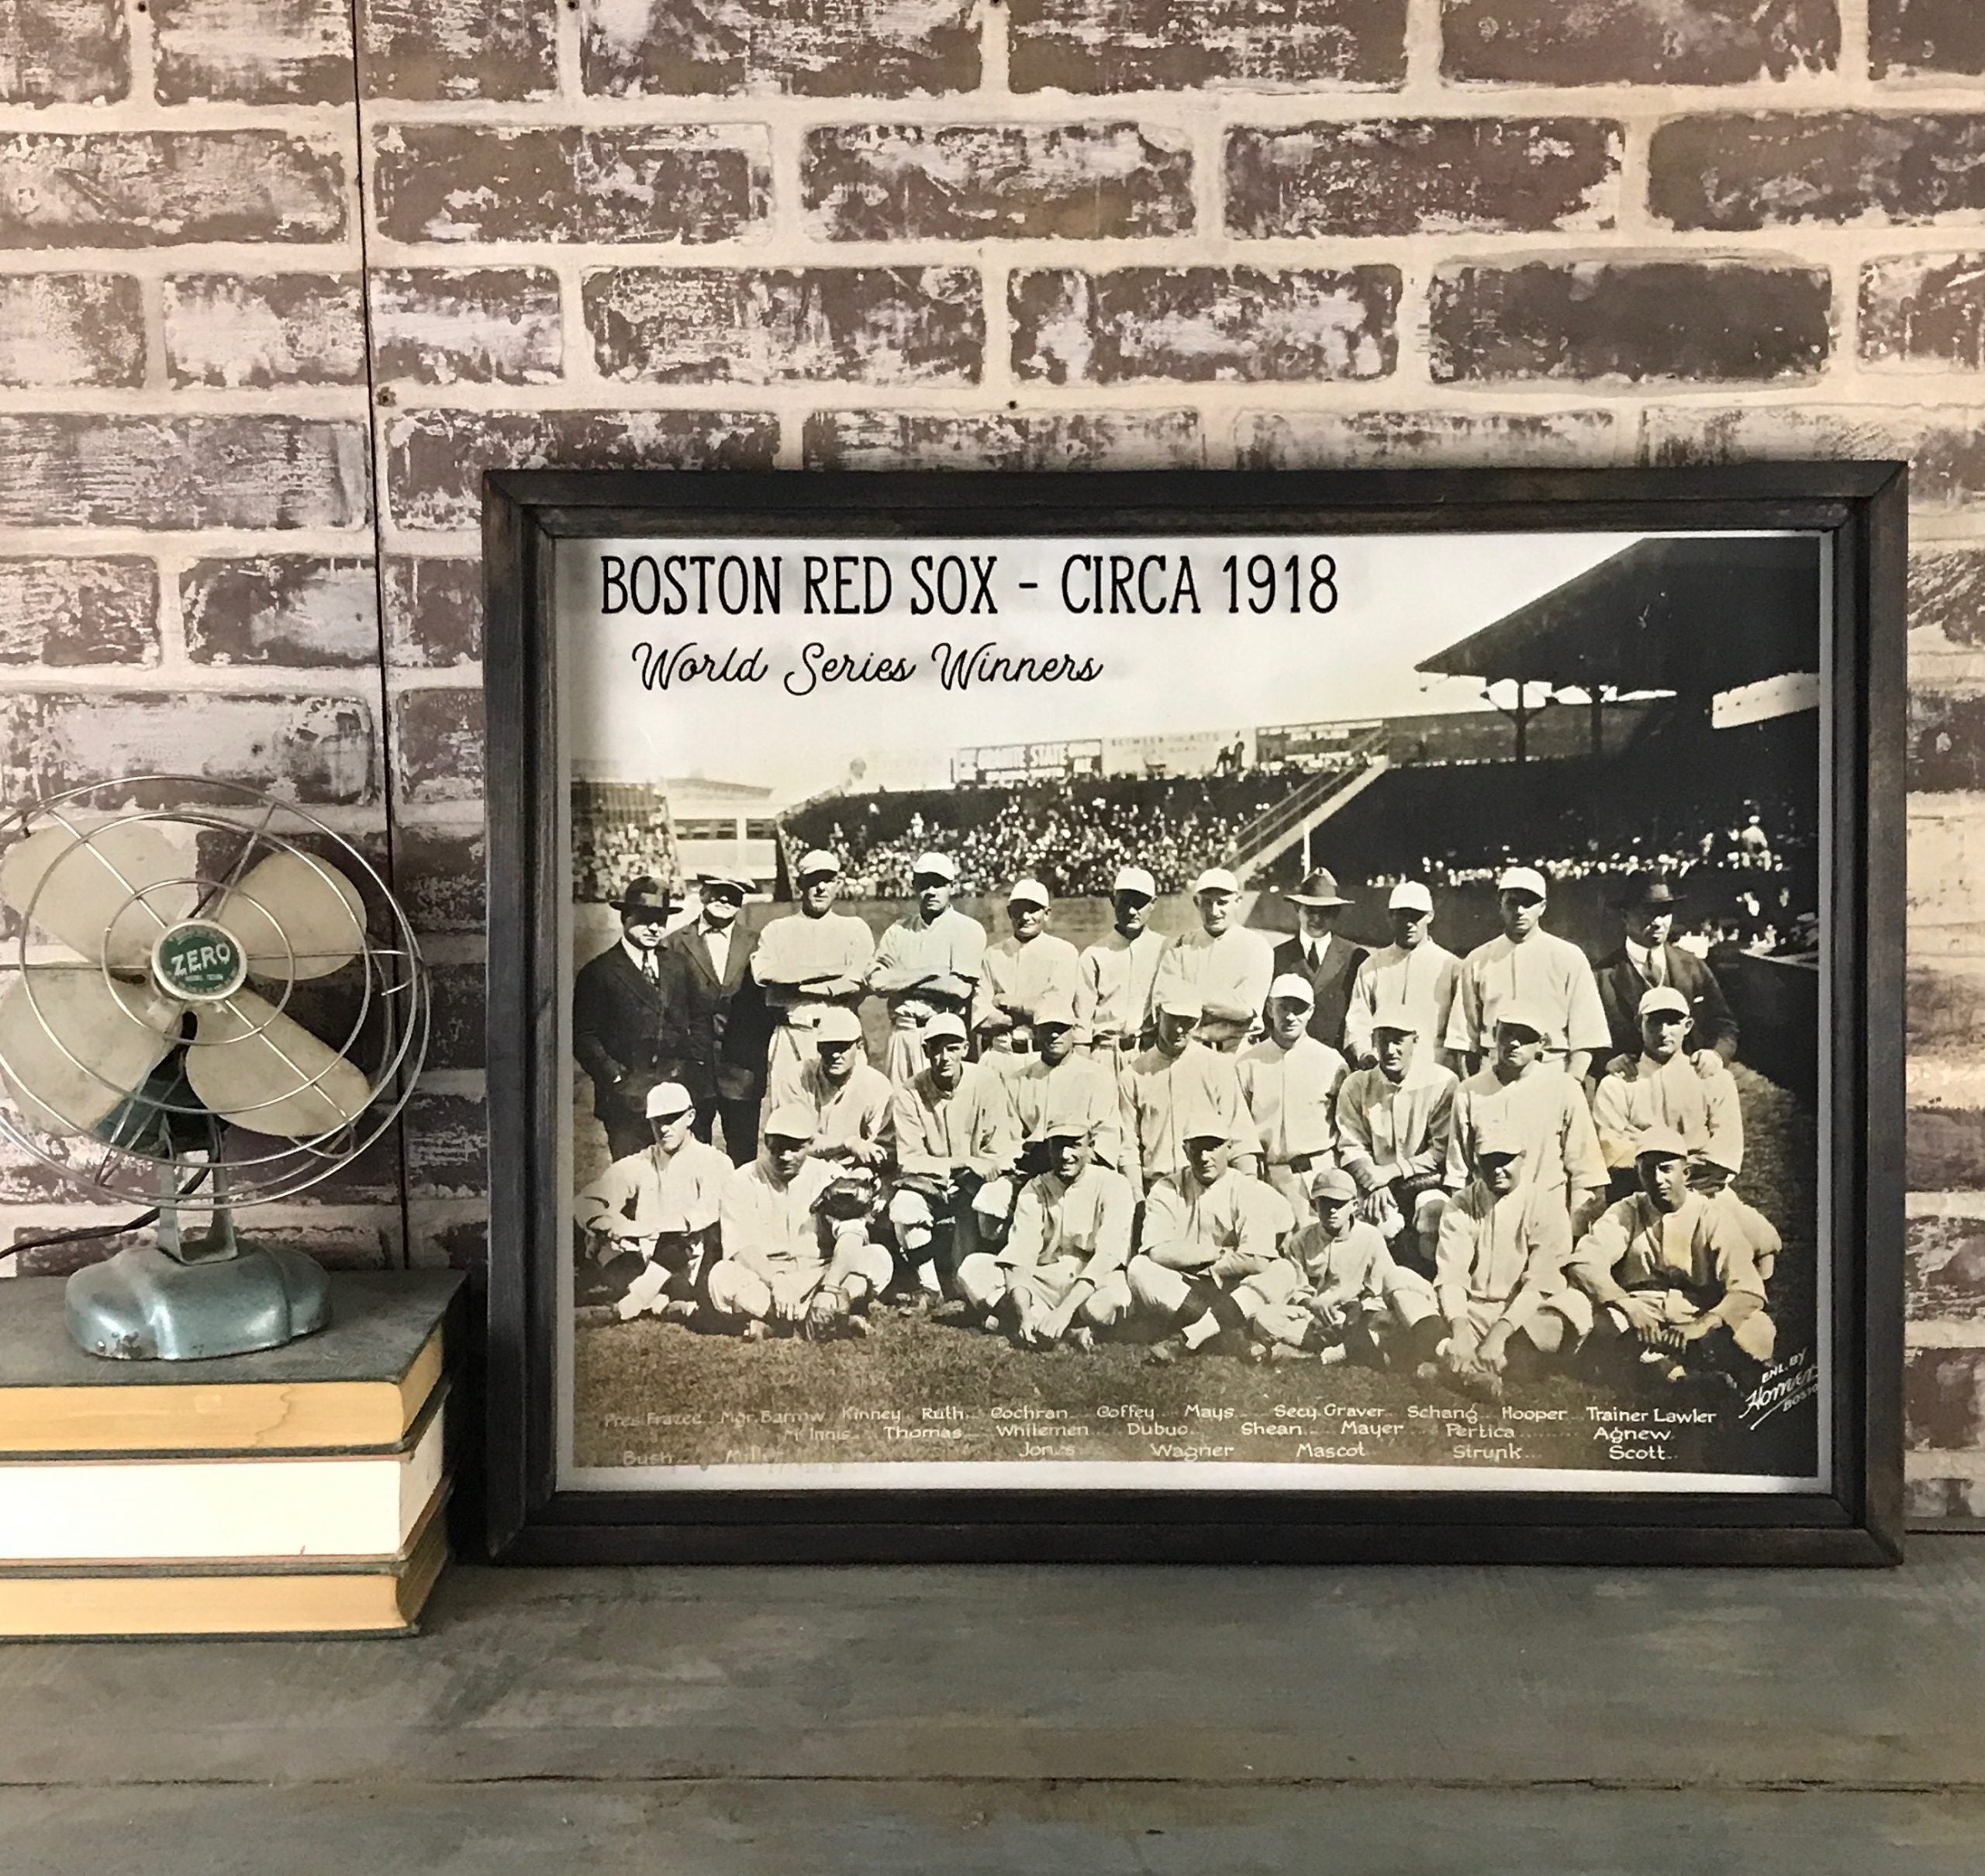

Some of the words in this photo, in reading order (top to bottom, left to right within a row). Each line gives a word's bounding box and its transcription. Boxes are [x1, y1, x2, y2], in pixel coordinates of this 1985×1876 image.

[601, 555, 782, 615] BOSTON
[803, 556, 892, 614] RED
[910, 555, 998, 615] SOX
[1062, 555, 1202, 613] CIRCA
[1222, 554, 1338, 613] 1918
[632, 642, 768, 690] World
[784, 642, 917, 696] Series
[931, 642, 1104, 690] Winners
[171, 942, 231, 976] ZERO
[842, 1406, 901, 1422] Kinney
[990, 1404, 1068, 1420] Cochran
[1096, 1404, 1155, 1421] Coffey
[1184, 1404, 1235, 1422] Mays
[1324, 1403, 1385, 1417] Graver
[1407, 1402, 1478, 1424] Schang
[1501, 1405, 1568, 1422] Hooper
[1586, 1406, 1648, 1422] Trainer
[1653, 1408, 1717, 1424] Lawler
[883, 1425, 962, 1439] Thomas
[1241, 1422, 1303, 1436] Shean
[1341, 1420, 1404, 1439] Mayer
[1445, 1422, 1515, 1438] Pertica
[1150, 1443, 1234, 1461] Wagner
[1296, 1442, 1365, 1458] Mascot
